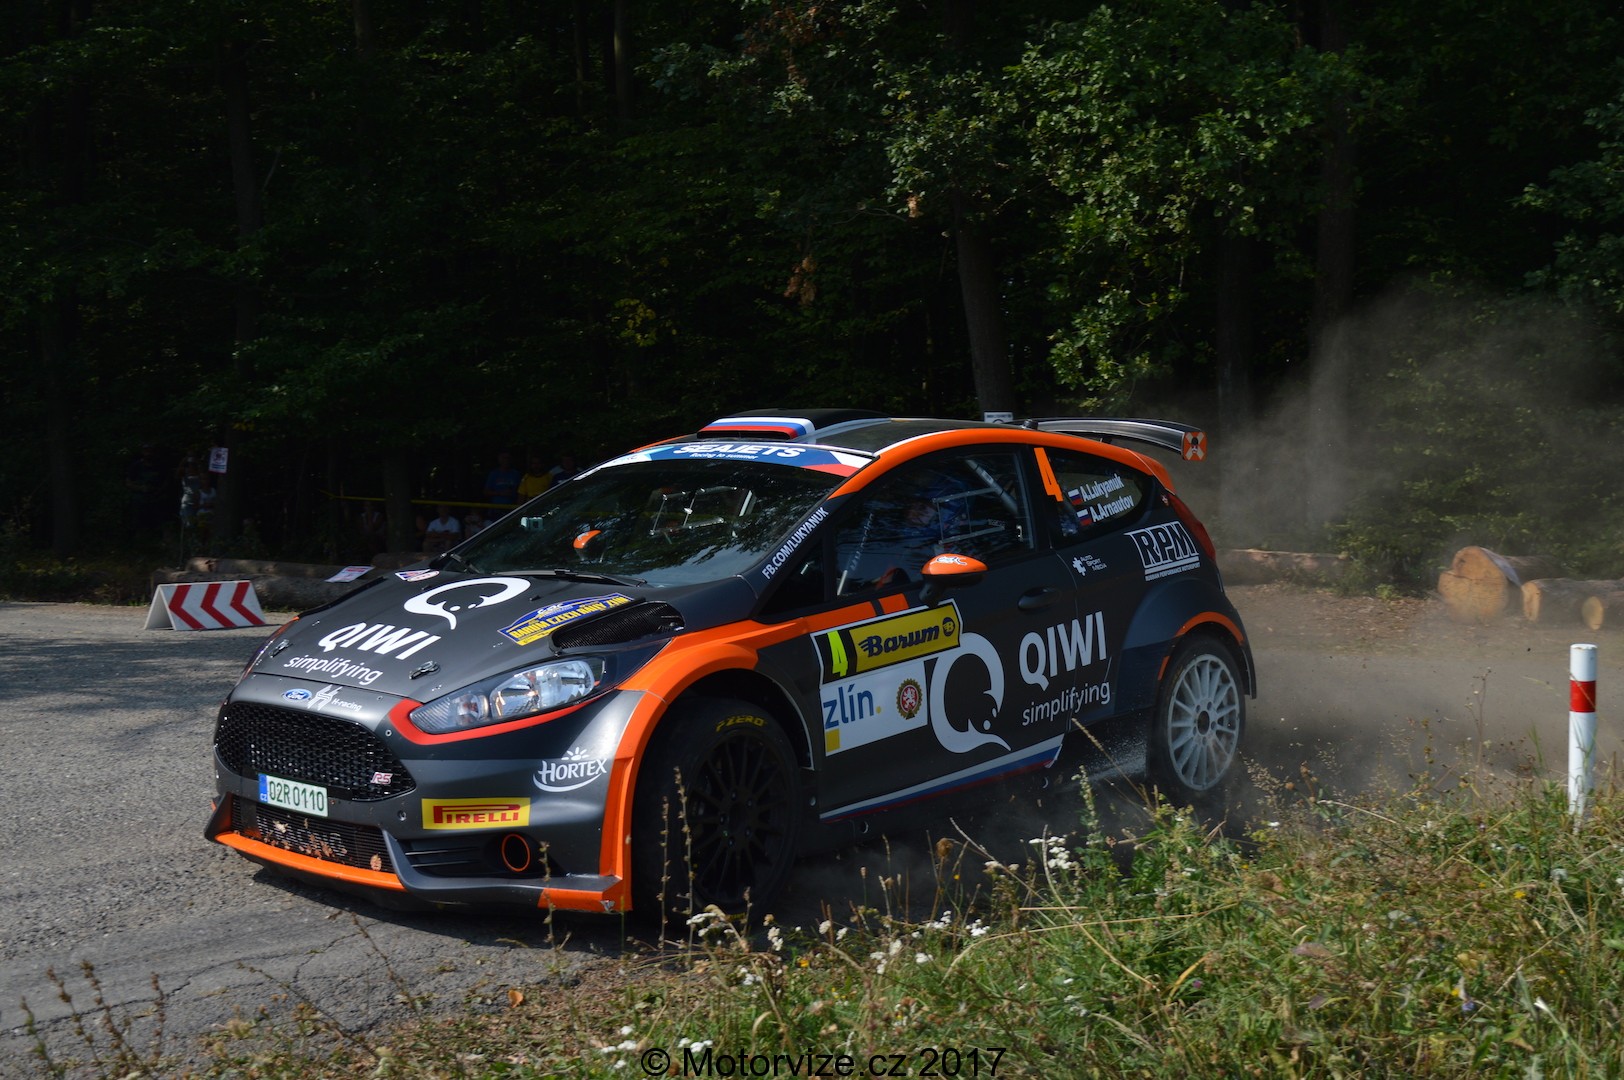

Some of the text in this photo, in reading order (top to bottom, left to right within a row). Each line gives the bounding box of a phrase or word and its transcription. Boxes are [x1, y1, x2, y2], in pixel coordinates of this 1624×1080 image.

[673, 444, 806, 458] SEAJETS
[1034, 447, 1064, 502] 4
[1080, 473, 1125, 502] A.Lukyanuk
[1089, 495, 1134, 523] A.Arnautov
[762, 507, 829, 580] FB.COM/LUKYANUK
[1128, 521, 1199, 568] RPM
[318, 622, 441, 660] QIWI
[827, 630, 848, 677] 4
[858, 625, 940, 658] Barum
[1019, 611, 1107, 691] QIWI
[284, 655, 384, 685] simplifying
[331, 698, 363, 712] H-racing
[1022, 682, 1111, 726] simplifying
[538, 758, 607, 785] HORTEX
[269, 780, 325, 812] 02R 0110
[433, 804, 521, 824] PIRELLI
